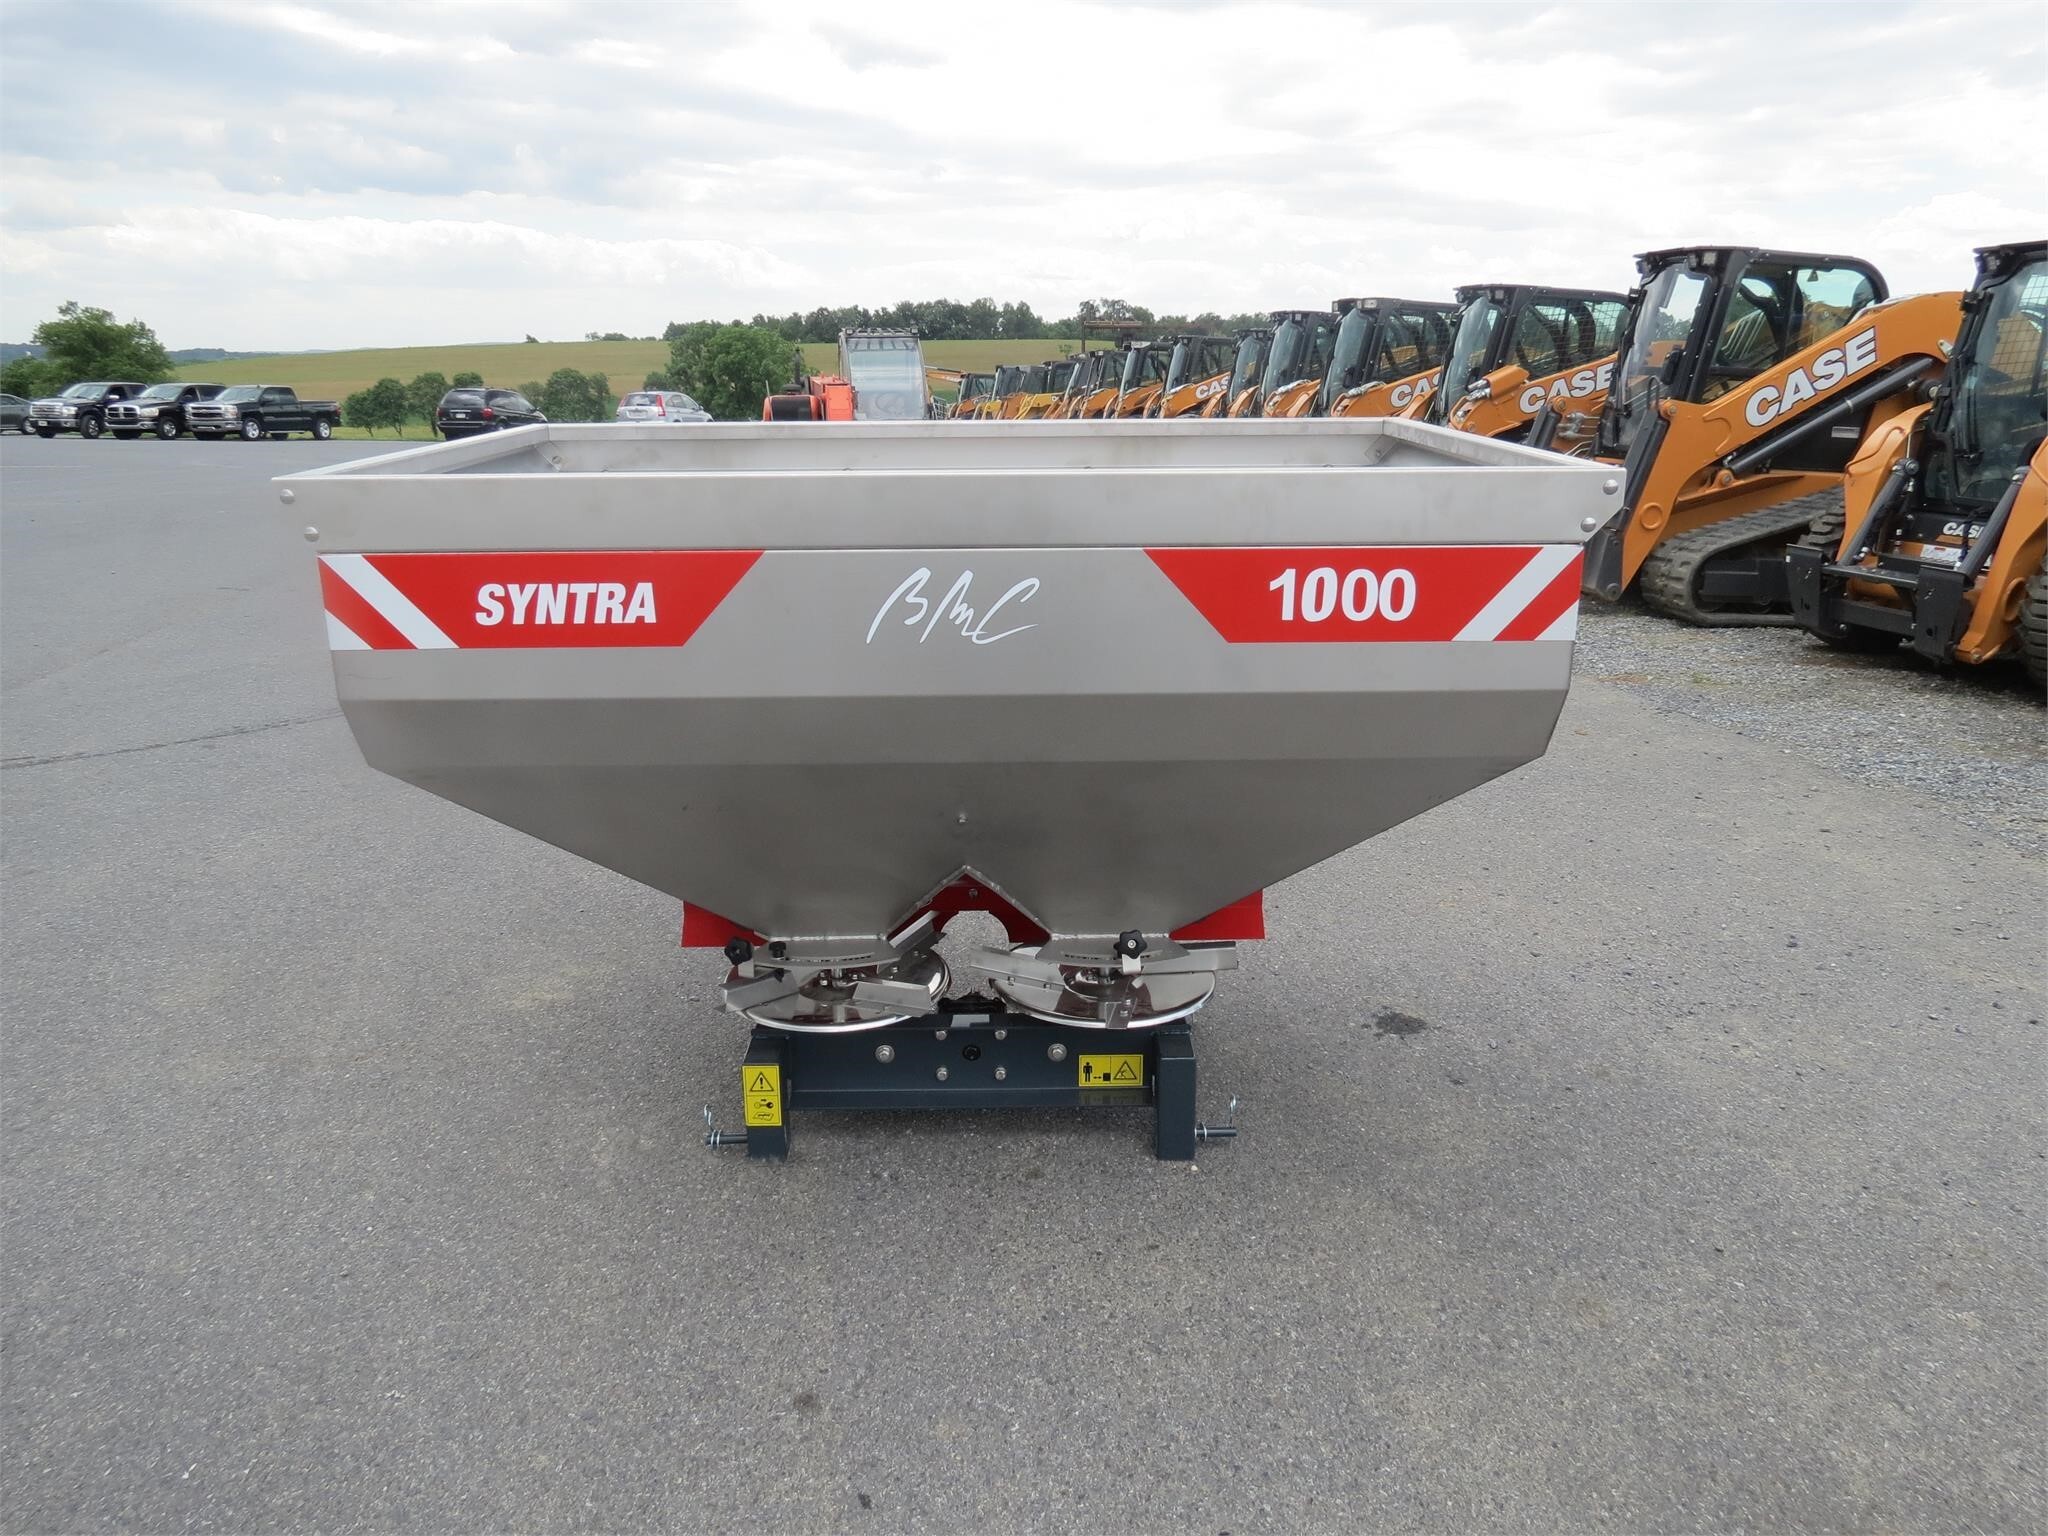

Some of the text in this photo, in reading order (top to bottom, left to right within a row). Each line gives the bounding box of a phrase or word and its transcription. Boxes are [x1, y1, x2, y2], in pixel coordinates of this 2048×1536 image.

[1196, 376, 1230, 399] CAS
[1391, 373, 1440, 407] CA
[1745, 326, 1877, 427] CASE
[1943, 522, 1984, 538] CAS
[475, 581, 657, 626] SYNTRA
[1268, 567, 1417, 623] 1000
